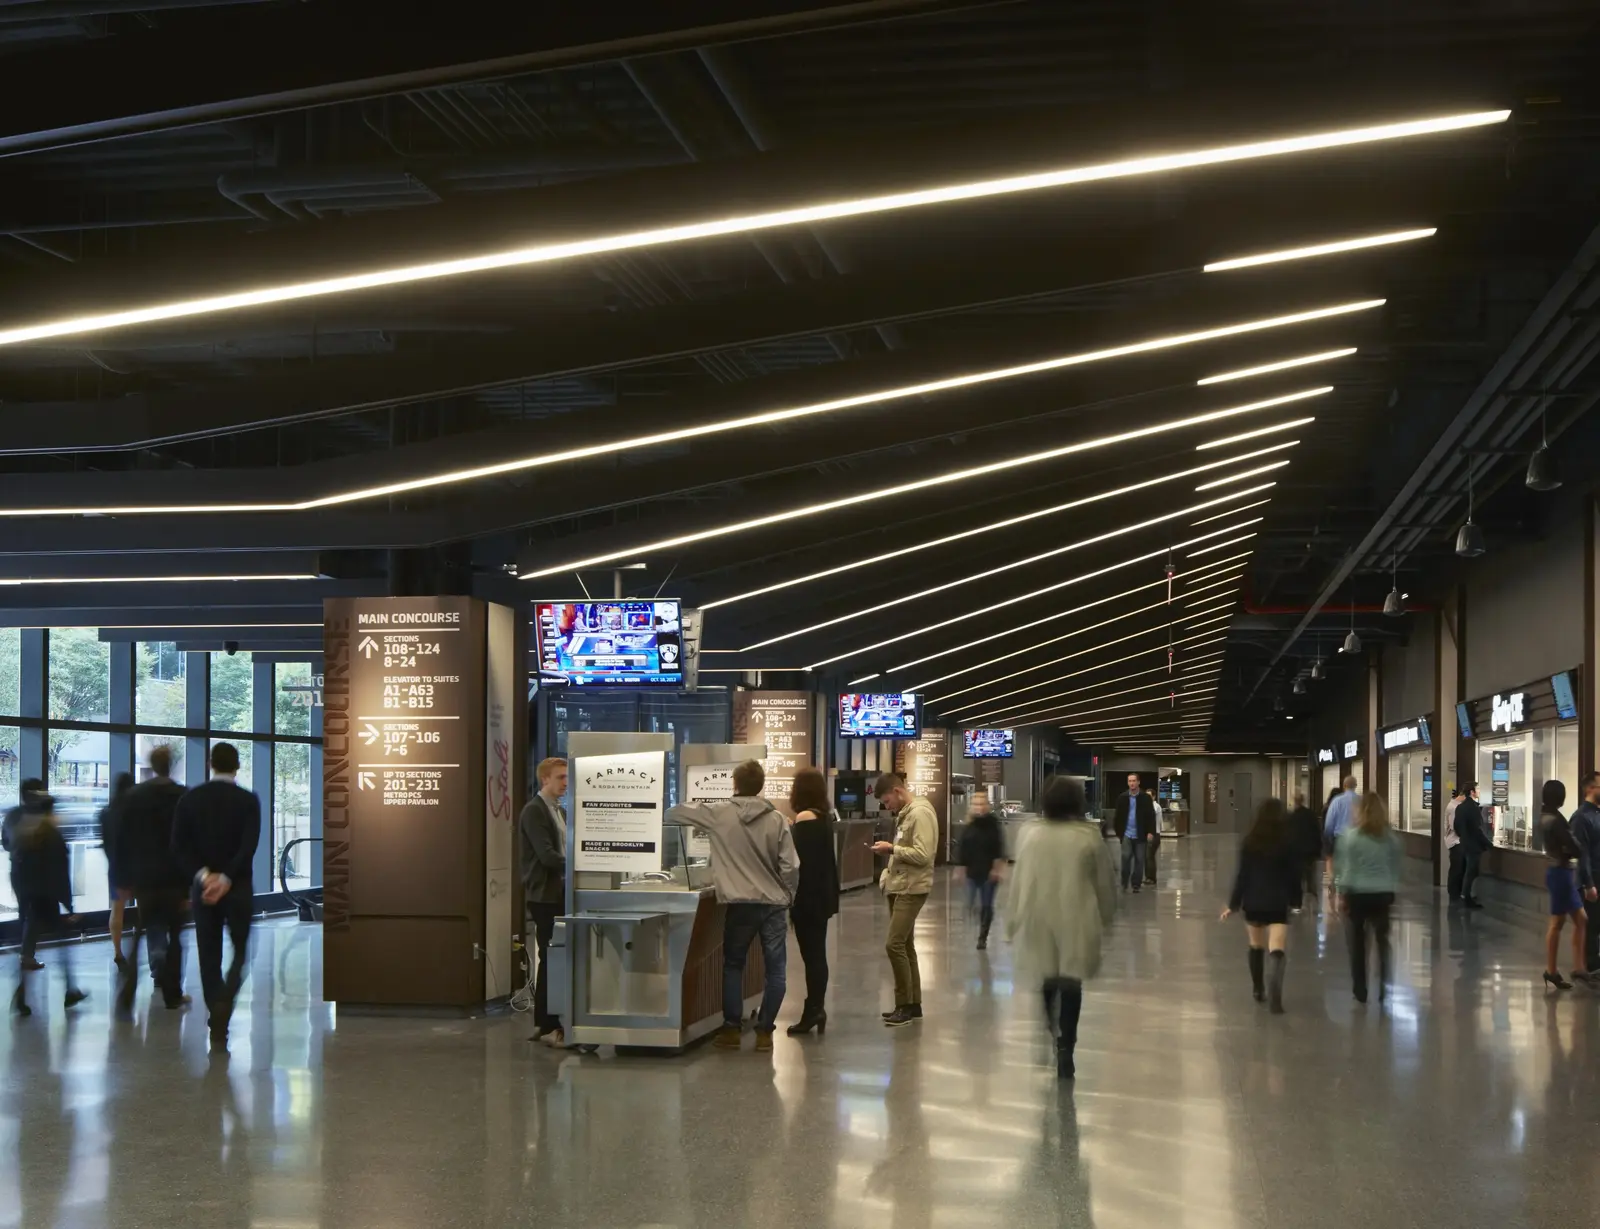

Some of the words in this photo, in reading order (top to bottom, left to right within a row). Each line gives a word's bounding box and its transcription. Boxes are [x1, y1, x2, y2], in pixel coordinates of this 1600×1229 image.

[358, 614, 388, 624] MAIN
[392, 612, 460, 623] CONCOURSE
[384, 643, 440, 655] 108-124
[384, 656, 416, 667] 8-24
[384, 685, 434, 696] A1-A63
[384, 697, 434, 708] B1-B15
[384, 732, 440, 743] 107-106
[384, 744, 408, 756] 7-6
[586, 768, 656, 785] FARMACY
[695, 773, 734, 787] FARM
[384, 780, 440, 790] 201-231
